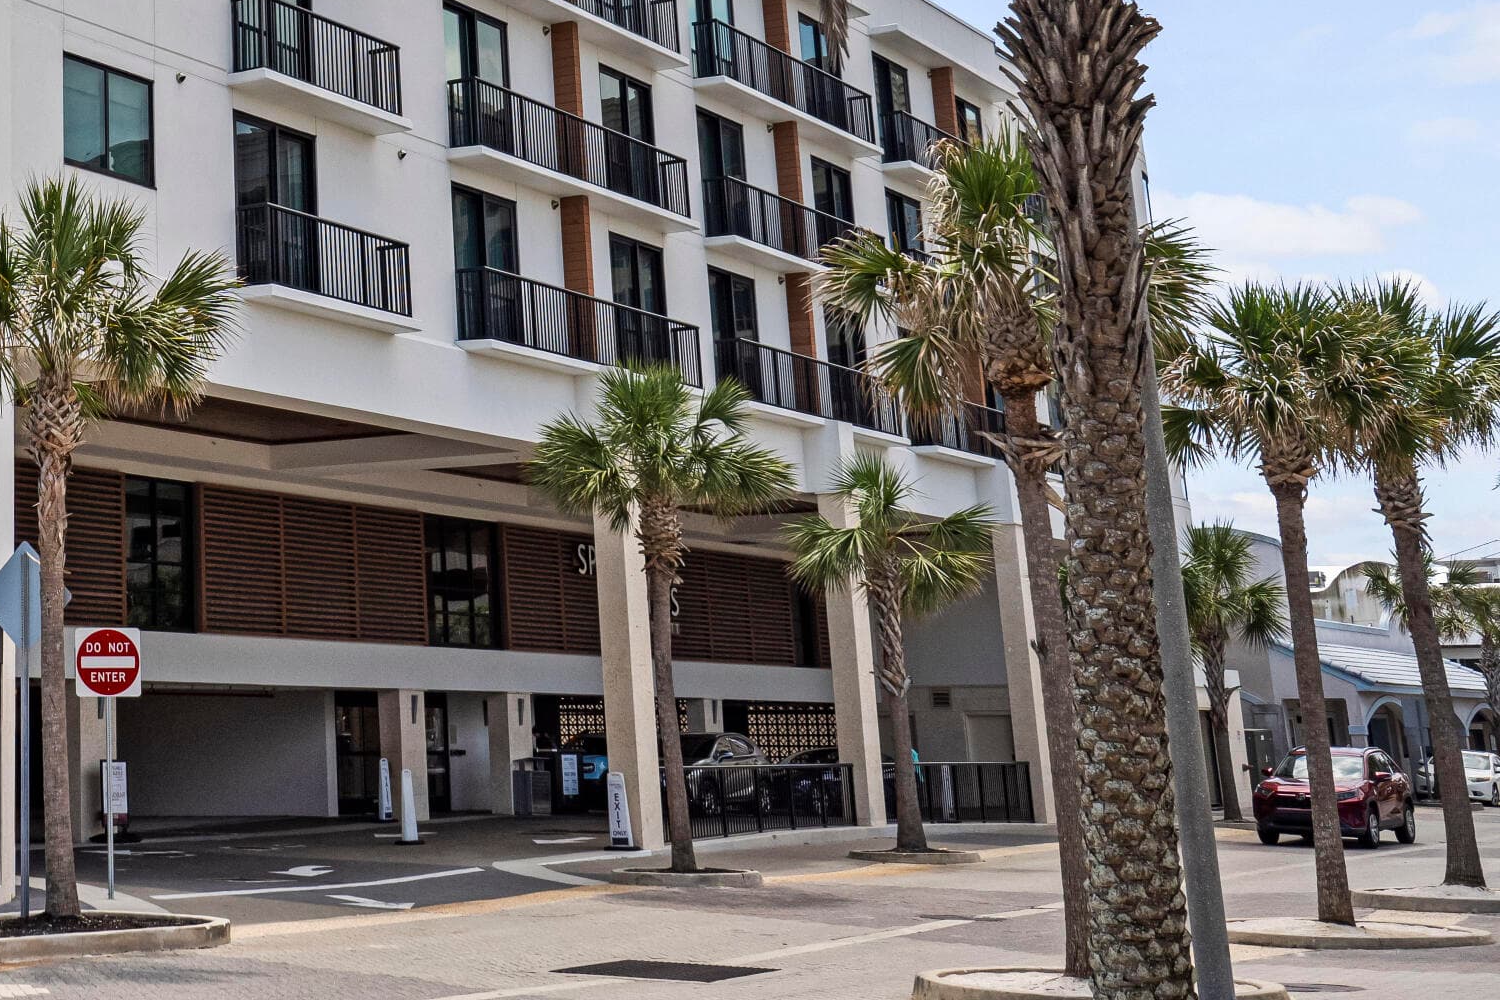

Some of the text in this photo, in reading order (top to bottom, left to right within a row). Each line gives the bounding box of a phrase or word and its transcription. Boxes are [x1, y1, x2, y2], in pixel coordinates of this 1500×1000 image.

[86, 642, 130, 653] DO NOT
[91, 672, 125, 682] ENTER
